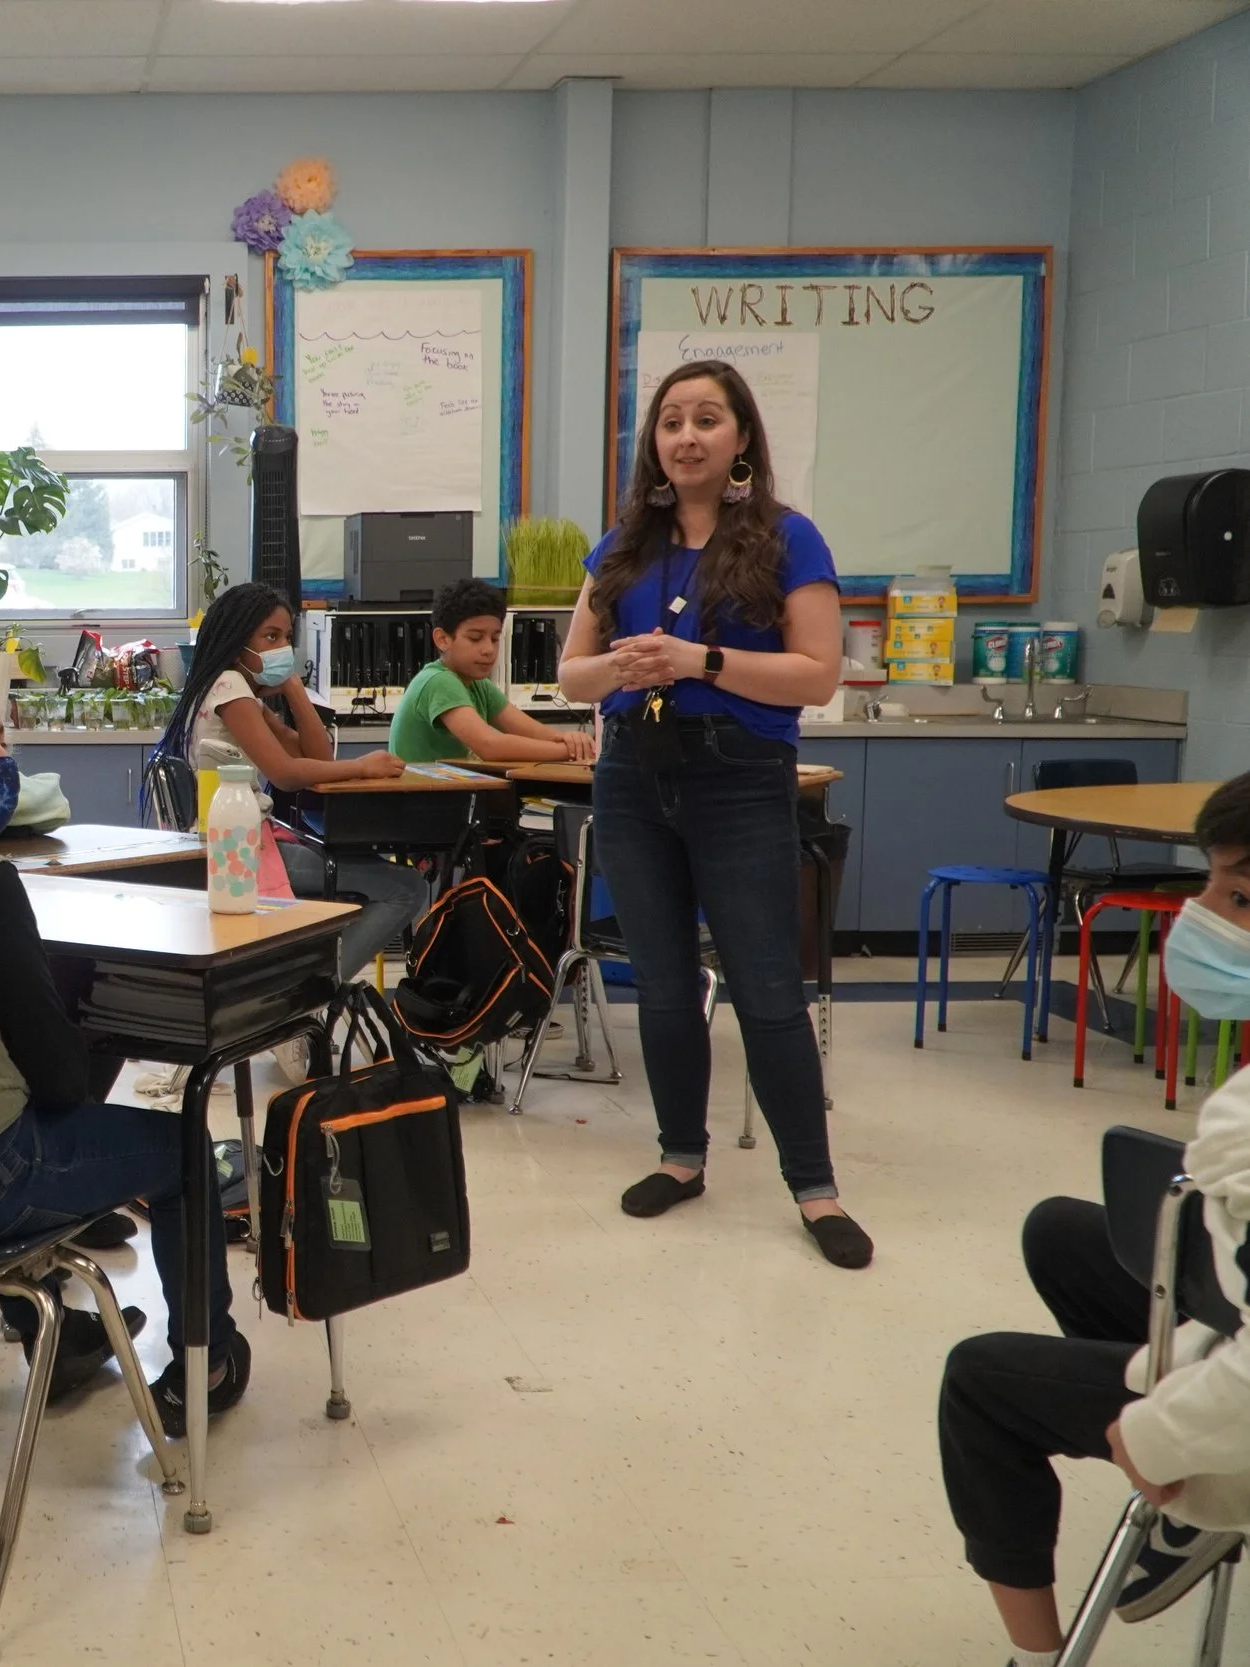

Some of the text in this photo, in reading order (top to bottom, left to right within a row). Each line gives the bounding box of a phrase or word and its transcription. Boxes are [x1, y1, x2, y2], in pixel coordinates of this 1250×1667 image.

[691, 282, 935, 327] WRITING
[421, 342, 461, 363] Focusing
[422, 354, 469, 371] the book
[678, 334, 784, 365] Engagement
